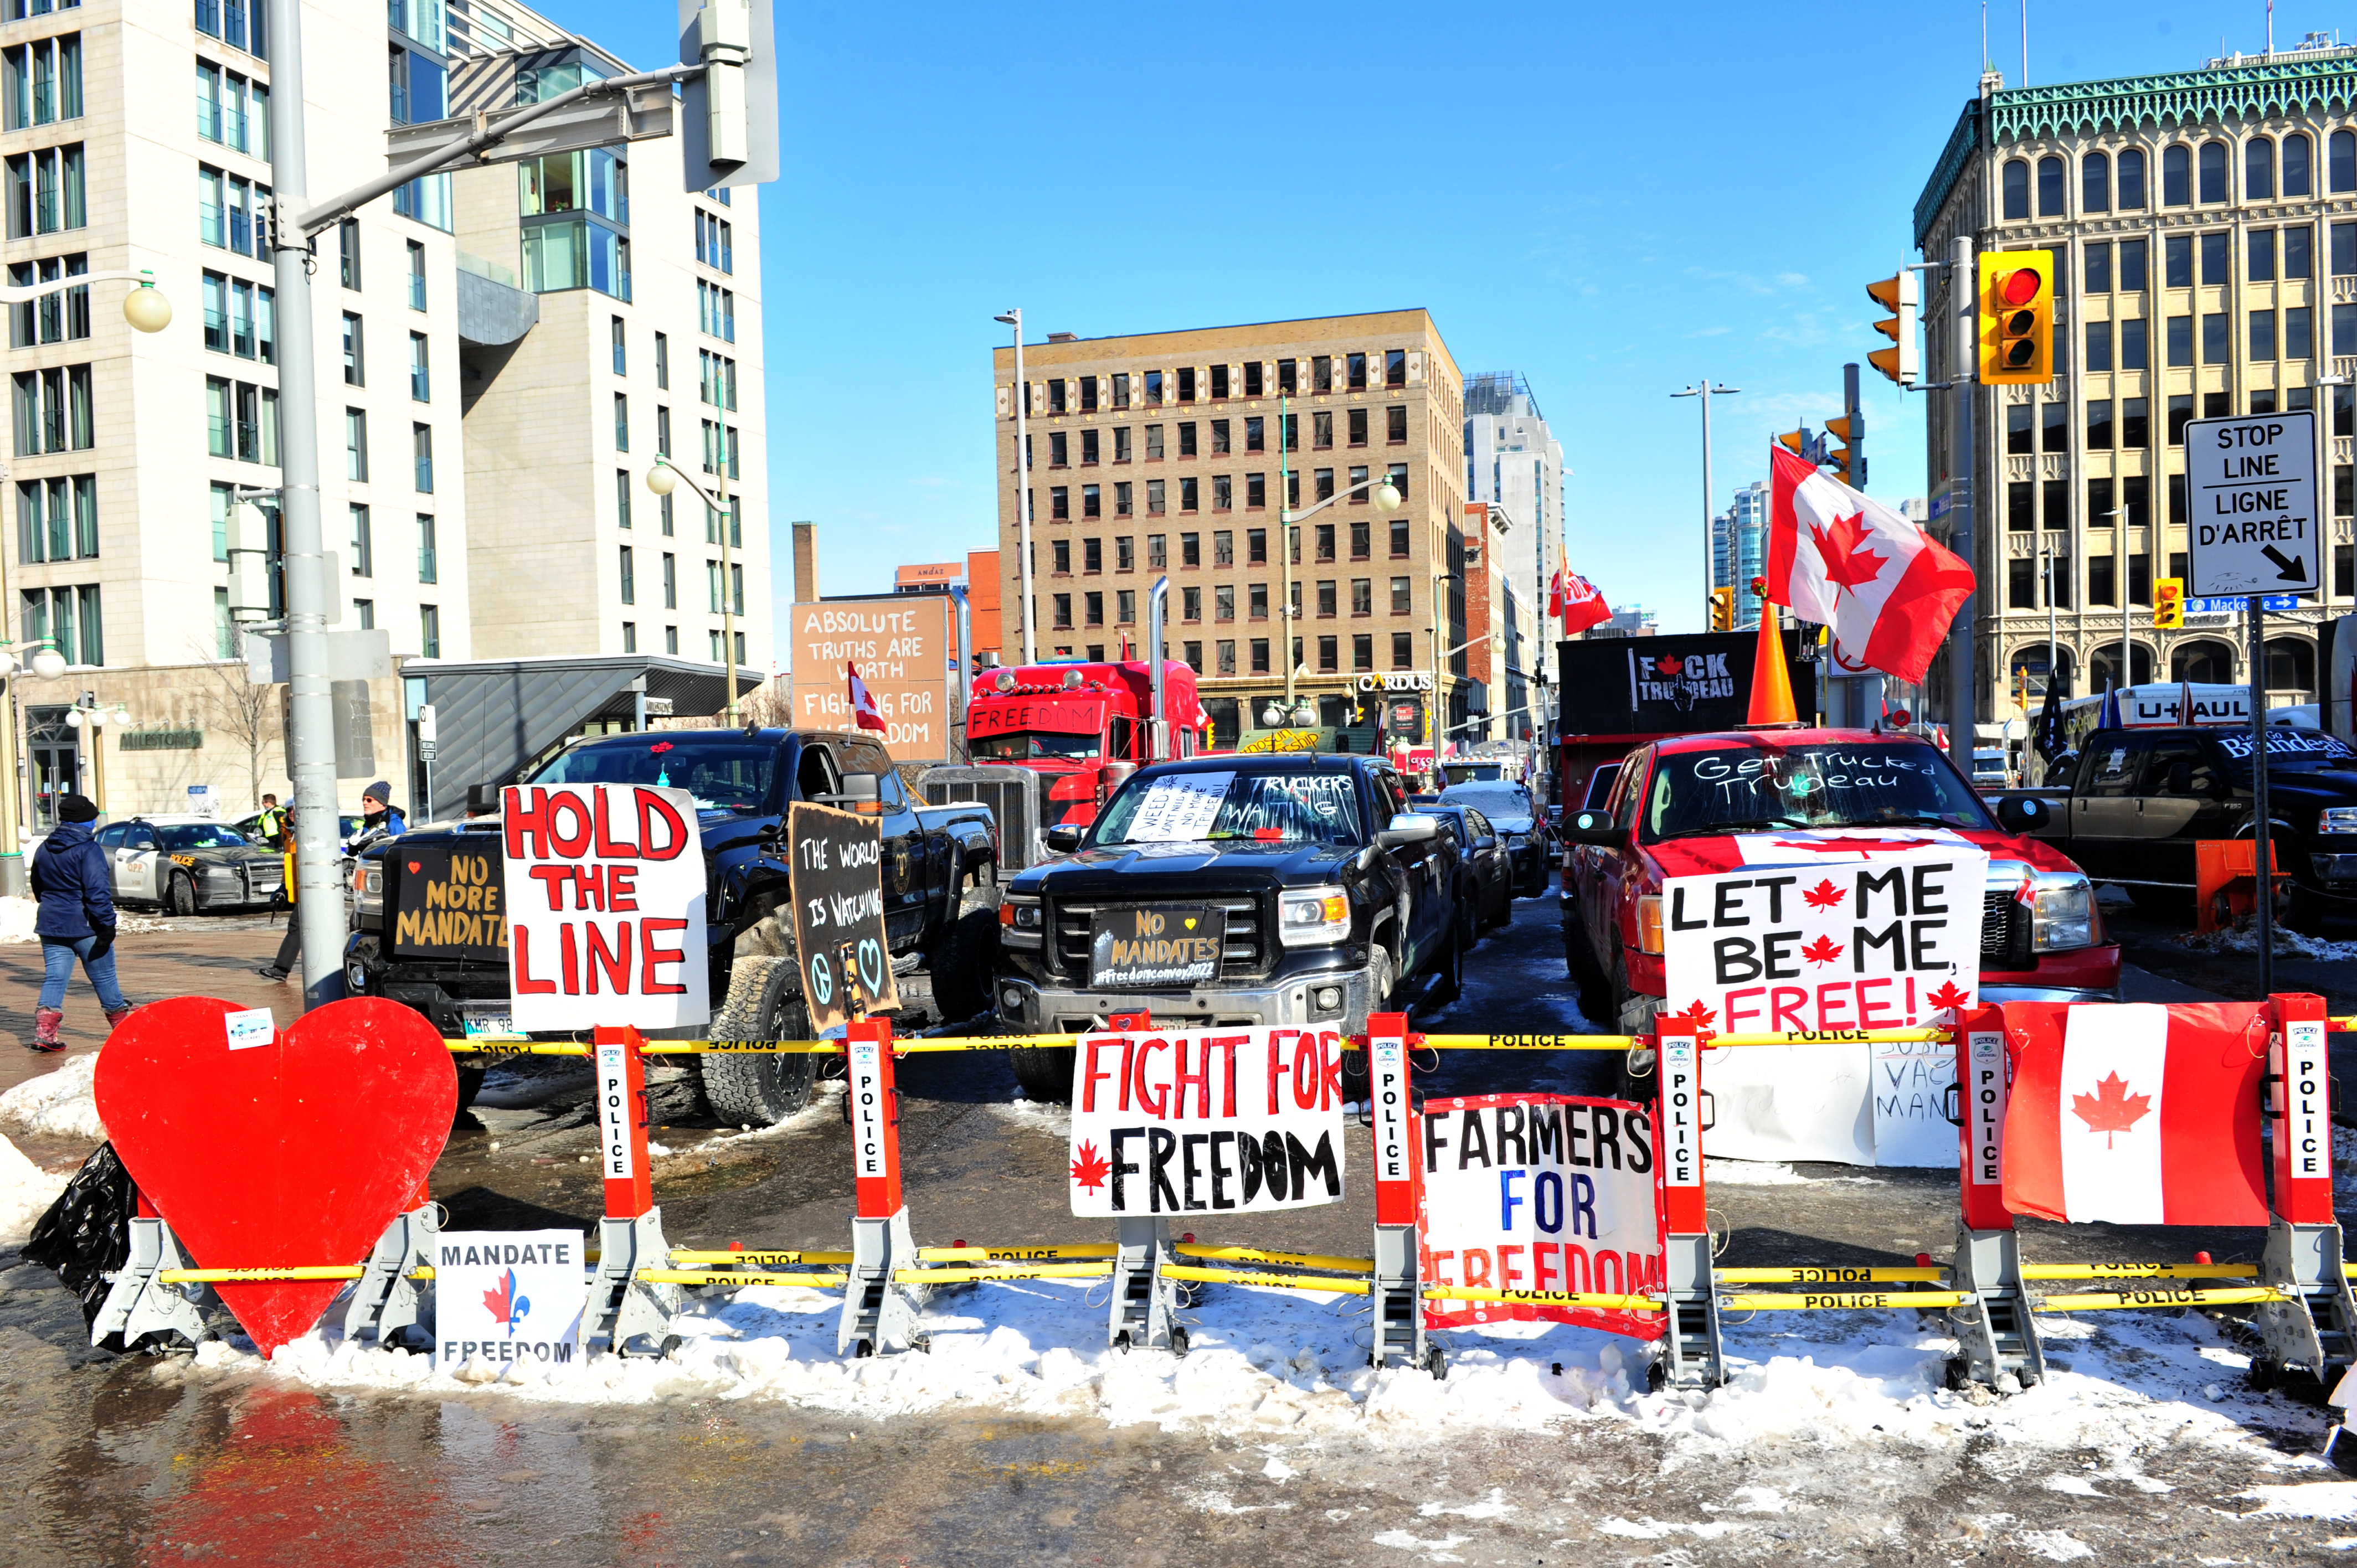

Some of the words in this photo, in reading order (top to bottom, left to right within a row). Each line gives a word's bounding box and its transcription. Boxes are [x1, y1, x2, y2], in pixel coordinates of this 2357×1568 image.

[2217, 424, 2283, 450] STOP
[2224, 454, 2280, 479] LINE
[2216, 490, 2288, 514] LIGNE
[2200, 515, 2307, 546] D'ARRÊT
[2211, 597, 2270, 611] Mackee
[804, 611, 917, 635] ABSOLUTE
[808, 640, 877, 660] TRUTHS
[886, 637, 923, 658] ARE
[837, 661, 904, 681] WORTH
[1359, 673, 1432, 691] CARDUS
[804, 692, 893, 718] FIGHNG
[900, 691, 932, 714] FOR
[972, 706, 1093, 732] FREEDOM
[1694, 754, 1781, 780] Get
[1805, 751, 1936, 775] Trucked
[1171, 796, 1184, 812] NEED
[1181, 782, 1192, 793] YOU
[1250, 776, 1351, 791] TRUCKERS
[1716, 773, 1898, 804] Trudeau
[1138, 795, 1169, 829] WEED
[1181, 813, 1195, 825] NO
[1188, 788, 1207, 808] MORE
[1192, 784, 1229, 830] TRUDEAU!
[503, 786, 688, 861] HOLD
[169, 854, 195, 866] POLICE
[800, 837, 828, 871] THE
[839, 839, 879, 869] WORLD
[451, 855, 488, 885] NO
[426, 880, 497, 911] MORE
[529, 864, 640, 912] THE
[1671, 876, 1797, 931] LET
[1856, 863, 1953, 920] ME
[808, 898, 826, 927] IS
[830, 888, 881, 927] WATCHING
[396, 911, 508, 947] MANDATE
[1136, 910, 1165, 937] NO
[514, 917, 688, 996] LINE
[1111, 937, 1219, 966] MANDATES
[1714, 930, 1803, 985] BE
[1853, 919, 1958, 976] ME,
[1725, 977, 1917, 1034] FREE!
[466, 1018, 490, 1033] KMR
[498, 1018, 512, 1032] 98
[1489, 1034, 1566, 1047] POLICE
[1788, 1030, 1869, 1041] POLICE
[1083, 1034, 1250, 1120] FIGHT
[1267, 1029, 1343, 1115] FOR
[608, 1079, 624, 1174] POLICE
[861, 1075, 876, 1172] POLICE
[1383, 1074, 1399, 1177] POLICE
[1673, 1075, 1689, 1181] POLICE
[1982, 1070, 1997, 1180] POLICE
[2300, 1061, 2317, 1172] POLICE
[1424, 1105, 1652, 1173] FARMERS
[1110, 1126, 1340, 1213] FREEDOM
[1500, 1170, 1598, 1240] FOR
[441, 1243, 569, 1266] MANDATE
[990, 1250, 1058, 1260] POLICE
[1428, 1242, 1658, 1315] FREEDOM
[1792, 1269, 1871, 1282] POLICE
[1501, 1288, 1580, 1301] POLICE
[1805, 1295, 1887, 1308] POLICE
[2118, 1291, 2206, 1304] POLICE
[444, 1342, 572, 1363] FREEDOM
